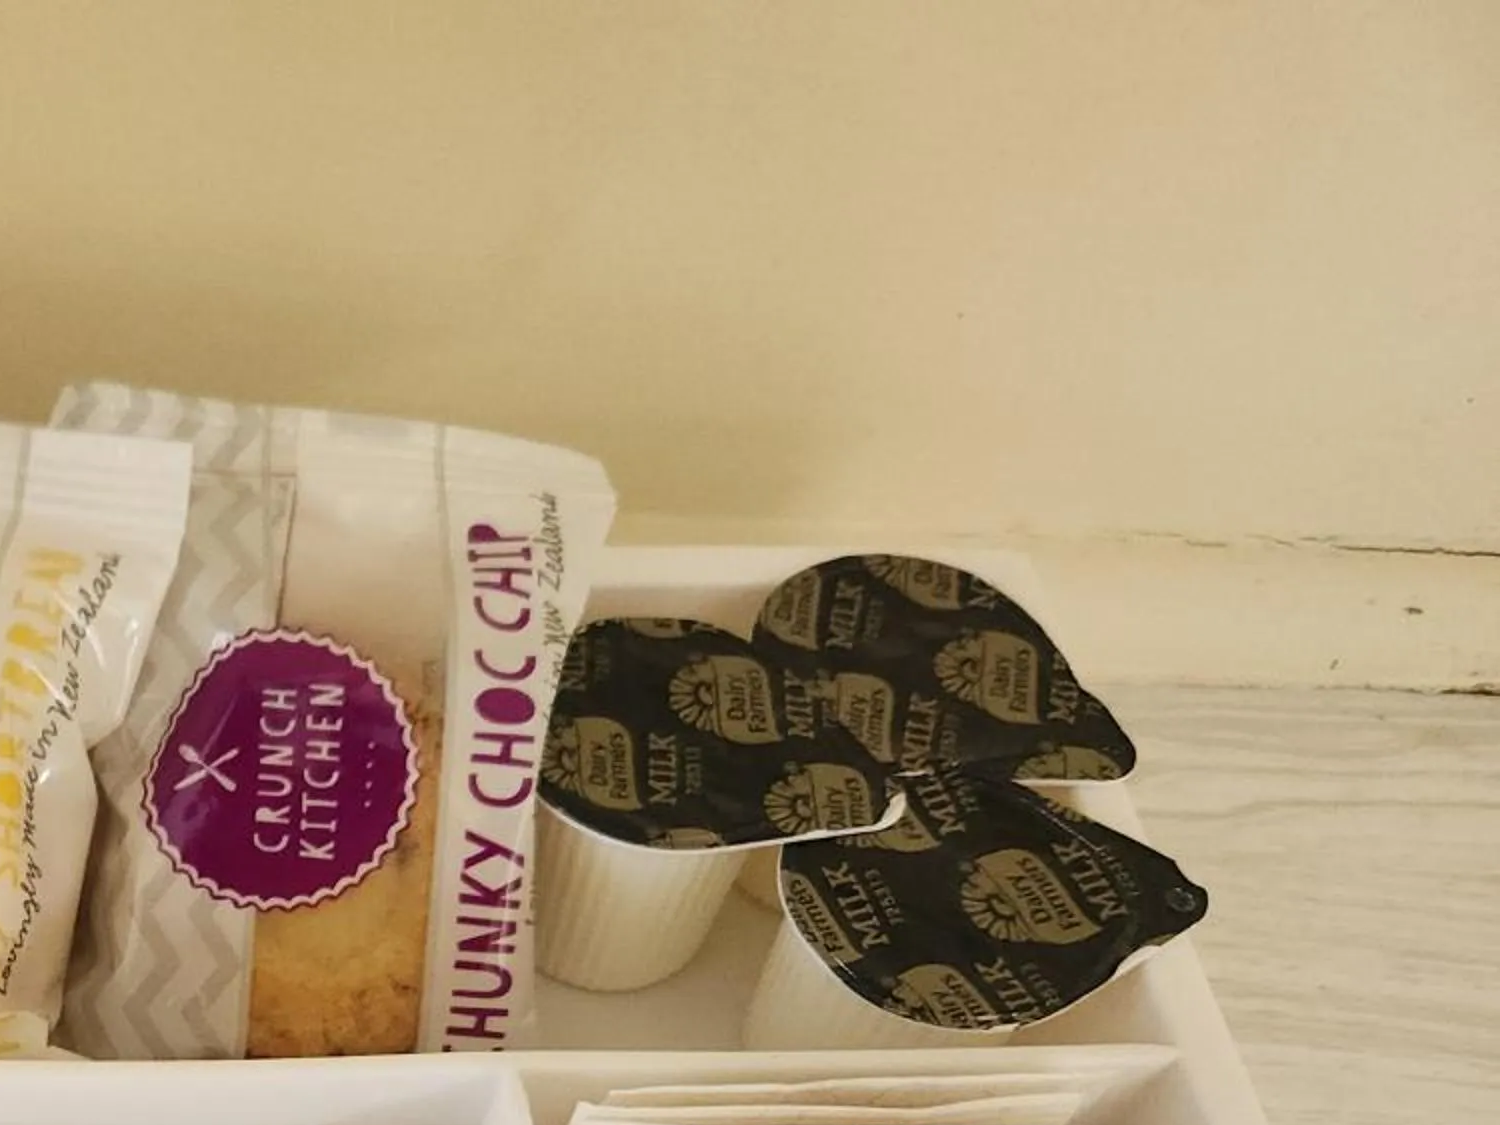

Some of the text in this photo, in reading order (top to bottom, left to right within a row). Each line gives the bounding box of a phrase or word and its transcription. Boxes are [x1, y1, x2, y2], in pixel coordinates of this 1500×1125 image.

[723, 673, 747, 722] Dairy
[746, 669, 768, 734] Farmers
[784, 668, 817, 740] MILK
[989, 655, 1012, 699] Dairy
[1009, 648, 1031, 714] Farmers
[31, 720, 59, 761] in
[252, 686, 299, 854] CRUNCH
[298, 682, 347, 861] KITCHEN
[609, 732, 630, 800] Farmers
[647, 732, 678, 805] MILK
[442, 522, 537, 1053] HUNKY CHOC CHIP
[821, 861, 891, 949] MILK
[1006, 873, 1054, 926] Dairy
[1014, 857, 1081, 932] Farmers
[1051, 838, 1129, 922] MILK
